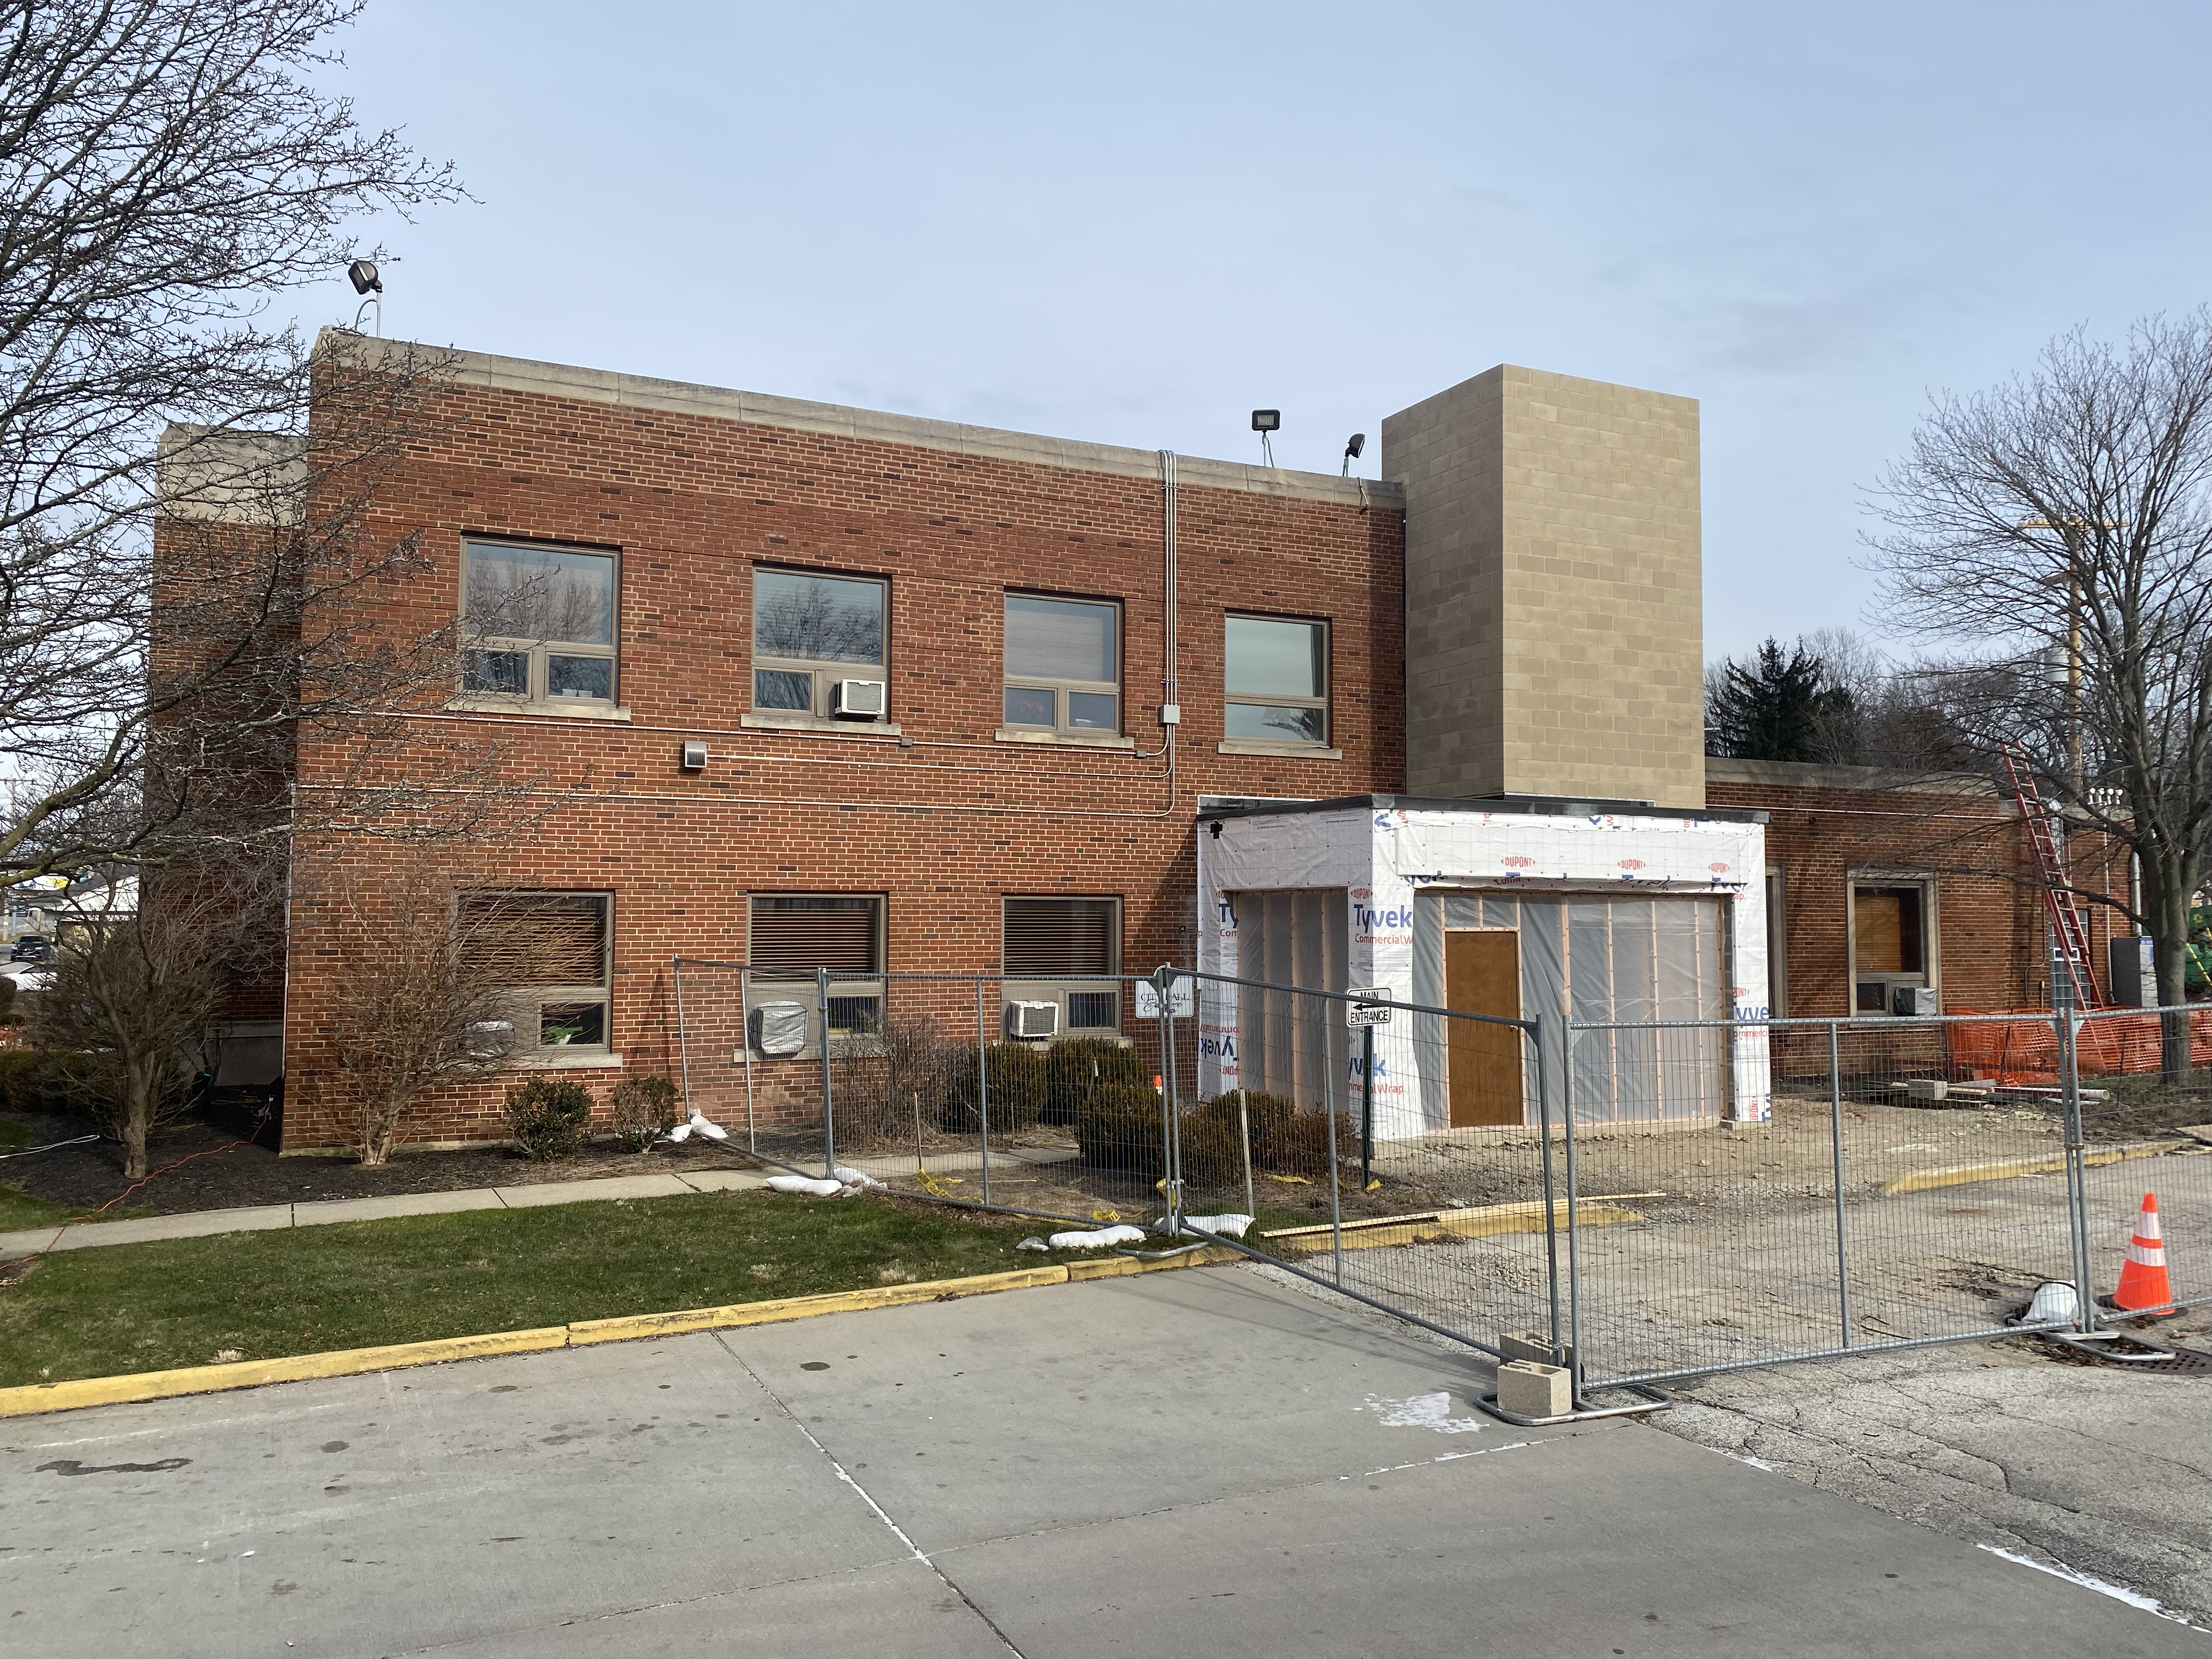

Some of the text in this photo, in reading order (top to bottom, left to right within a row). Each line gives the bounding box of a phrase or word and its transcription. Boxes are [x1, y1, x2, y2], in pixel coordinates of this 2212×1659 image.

[1505, 856, 1532, 867] DUPONT
[1621, 859, 1644, 870] DUPONT
[1711, 862, 1729, 873] DUPONT
[1353, 888, 1371, 900] DUPONT
[1353, 904, 1413, 934] Tyvek
[1355, 934, 1413, 944] CommercialW
[1360, 991, 1379, 1000] MAIN
[1351, 1010, 1388, 1024] ENTRANCE
[1200, 1035, 1238, 1061] yvek
